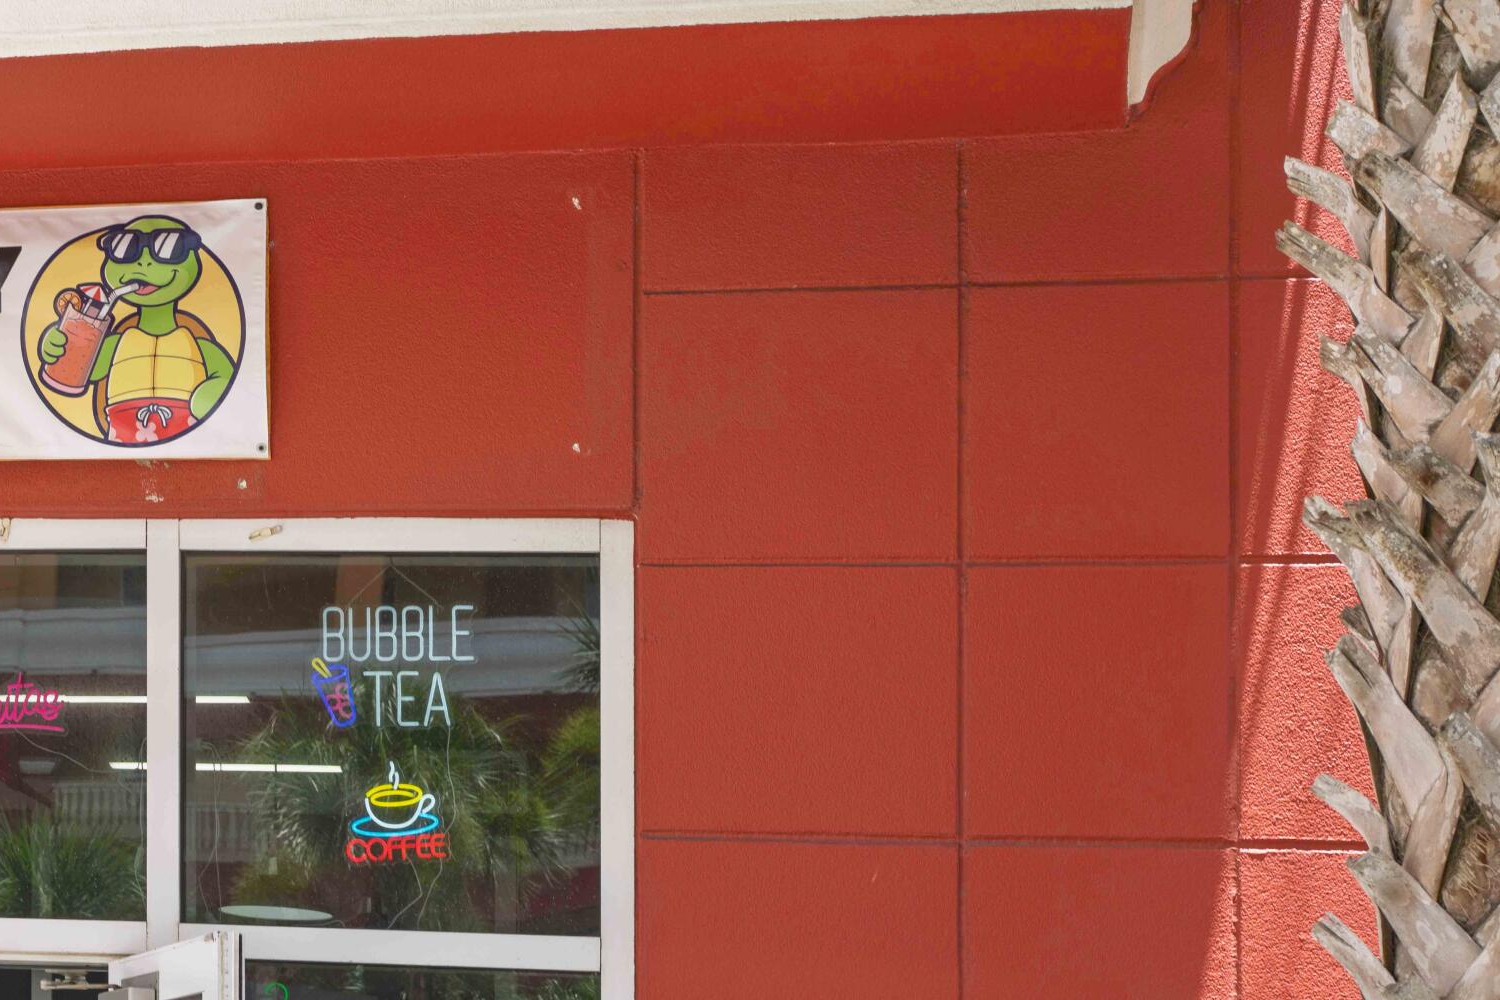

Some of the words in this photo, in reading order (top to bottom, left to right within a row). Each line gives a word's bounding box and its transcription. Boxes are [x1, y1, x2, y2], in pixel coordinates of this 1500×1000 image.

[323, 604, 475, 662] BUBBLE
[363, 670, 451, 727] TEA
[346, 832, 449, 863] COFFEE
